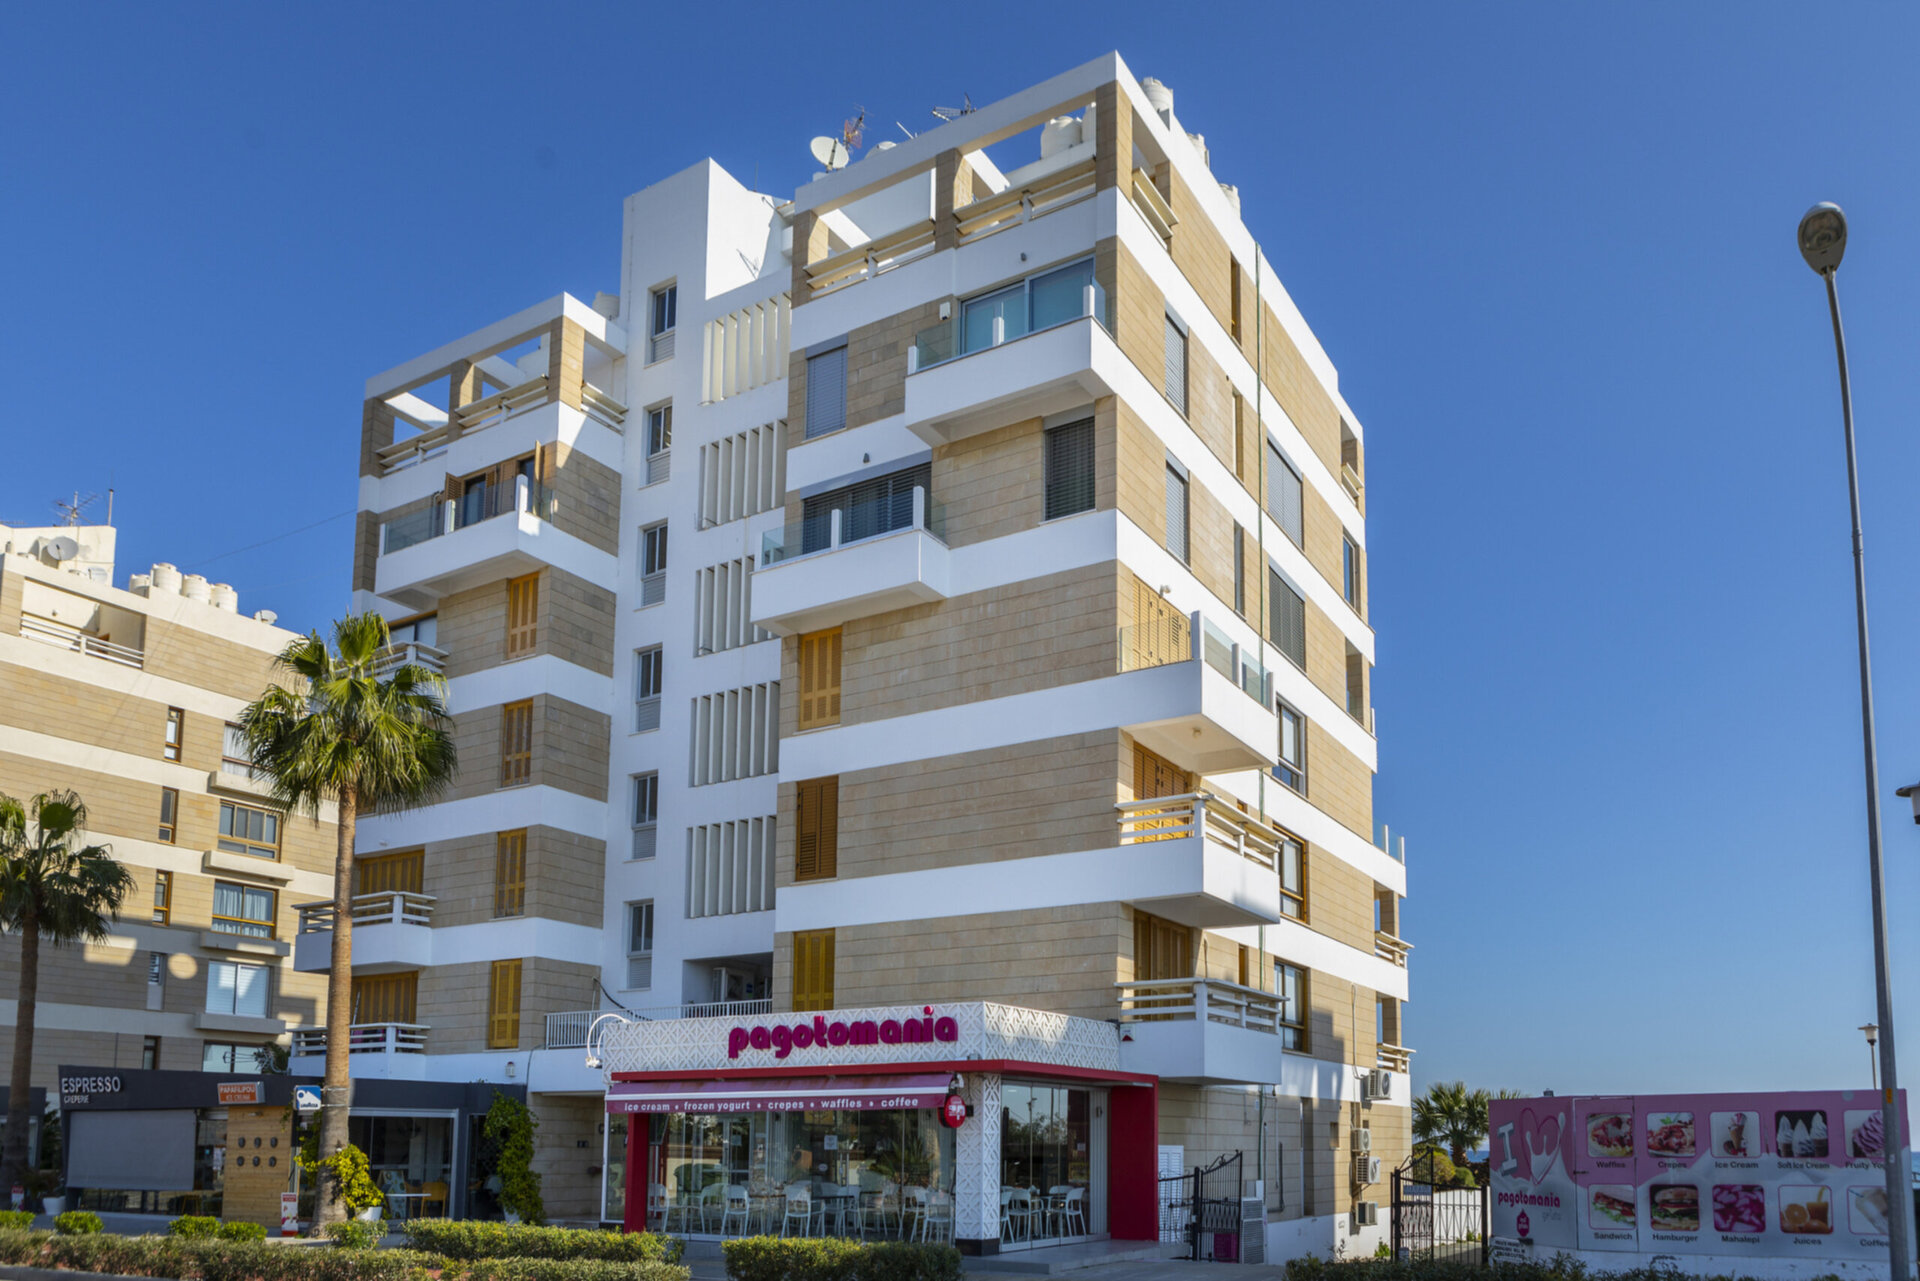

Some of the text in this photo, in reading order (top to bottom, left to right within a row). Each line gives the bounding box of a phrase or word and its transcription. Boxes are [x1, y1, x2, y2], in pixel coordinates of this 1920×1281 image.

[728, 1005, 958, 1059] pagotomania
[61, 1076, 121, 1093] ESPRESSO
[624, 1102, 638, 1111] ice
[684, 1101, 715, 1111] frozen
[717, 1101, 750, 1112] yogurt
[768, 1101, 804, 1111] crepes
[821, 1098, 862, 1108] waffles
[881, 1097, 918, 1107] coffee
[1596, 1161, 1626, 1169] Waffles
[1658, 1161, 1687, 1170] Crepes
[1715, 1161, 1759, 1169] Ice Cream
[1777, 1161, 1830, 1169] Soft Ice Cream
[1845, 1161, 1869, 1170] Fruity
[1498, 1190, 1560, 1208] pagotomania
[1594, 1232, 1633, 1241] Sandwich
[1652, 1233, 1699, 1243] Hamburger
[1721, 1235, 1761, 1244] Mahalepi
[1793, 1237, 1822, 1245] Juices
